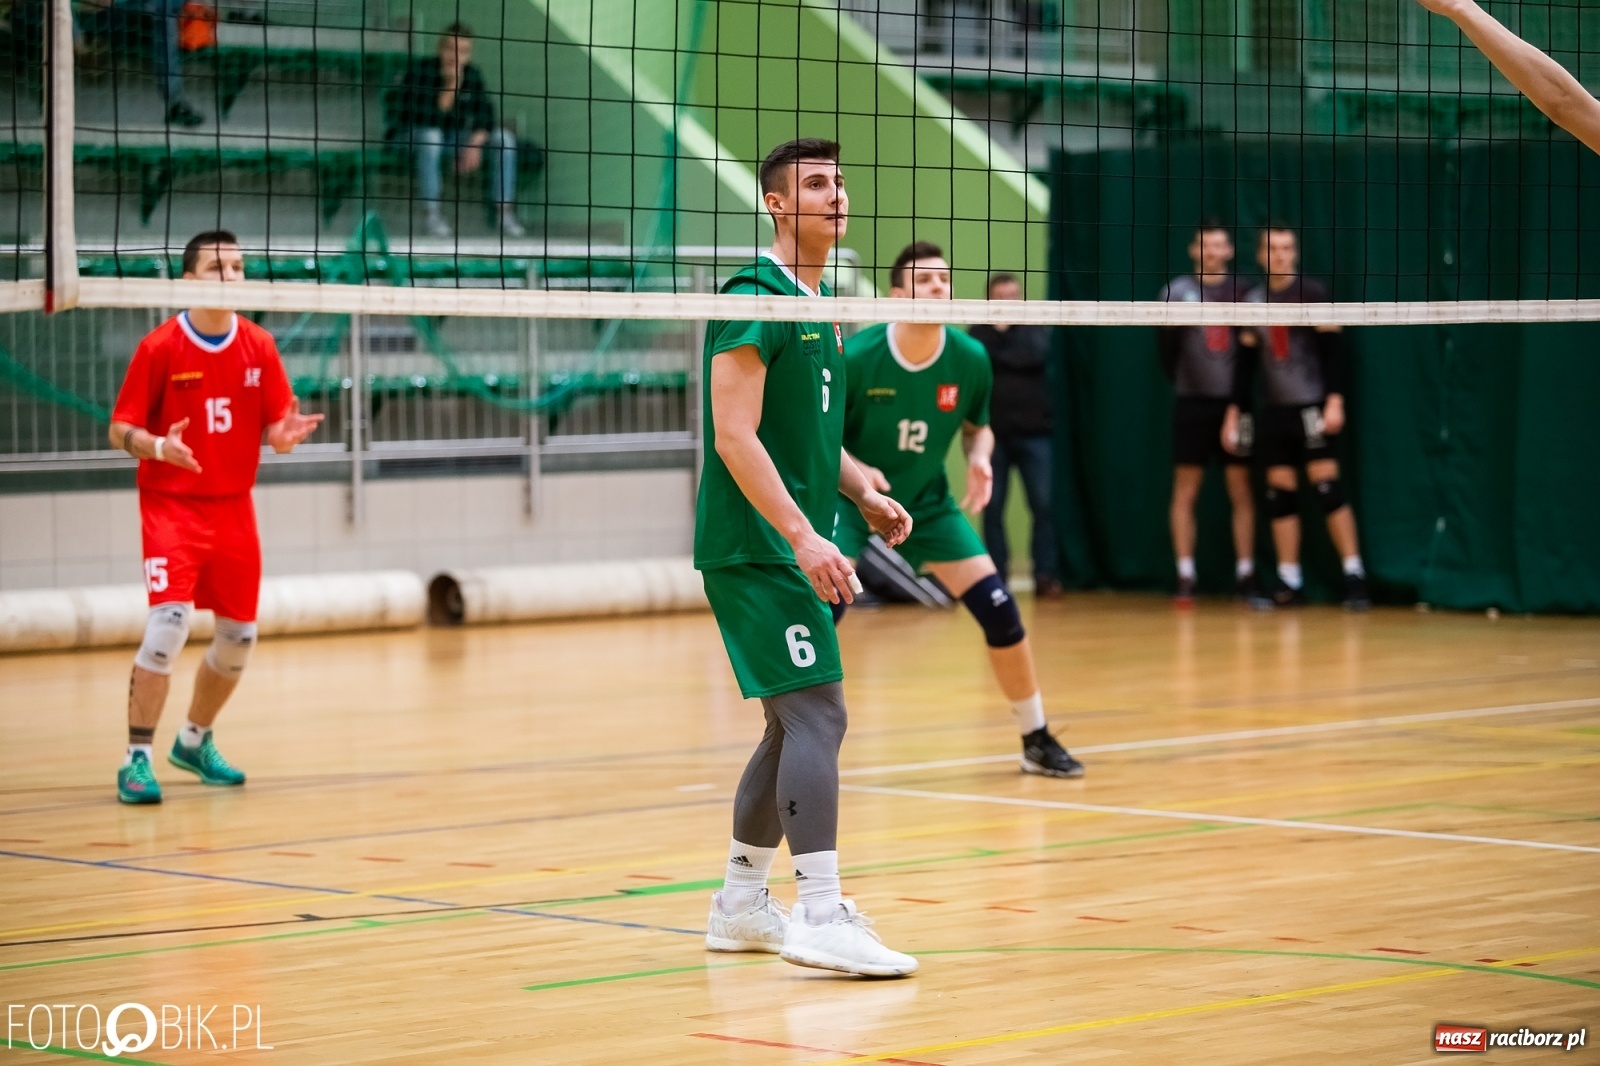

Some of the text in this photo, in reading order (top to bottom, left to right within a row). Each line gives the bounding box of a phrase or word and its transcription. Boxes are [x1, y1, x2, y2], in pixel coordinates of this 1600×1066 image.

[205, 397, 232, 434] 15
[897, 418, 928, 454] 12
[144, 556, 168, 594] 15
[784, 624, 817, 668] 6
